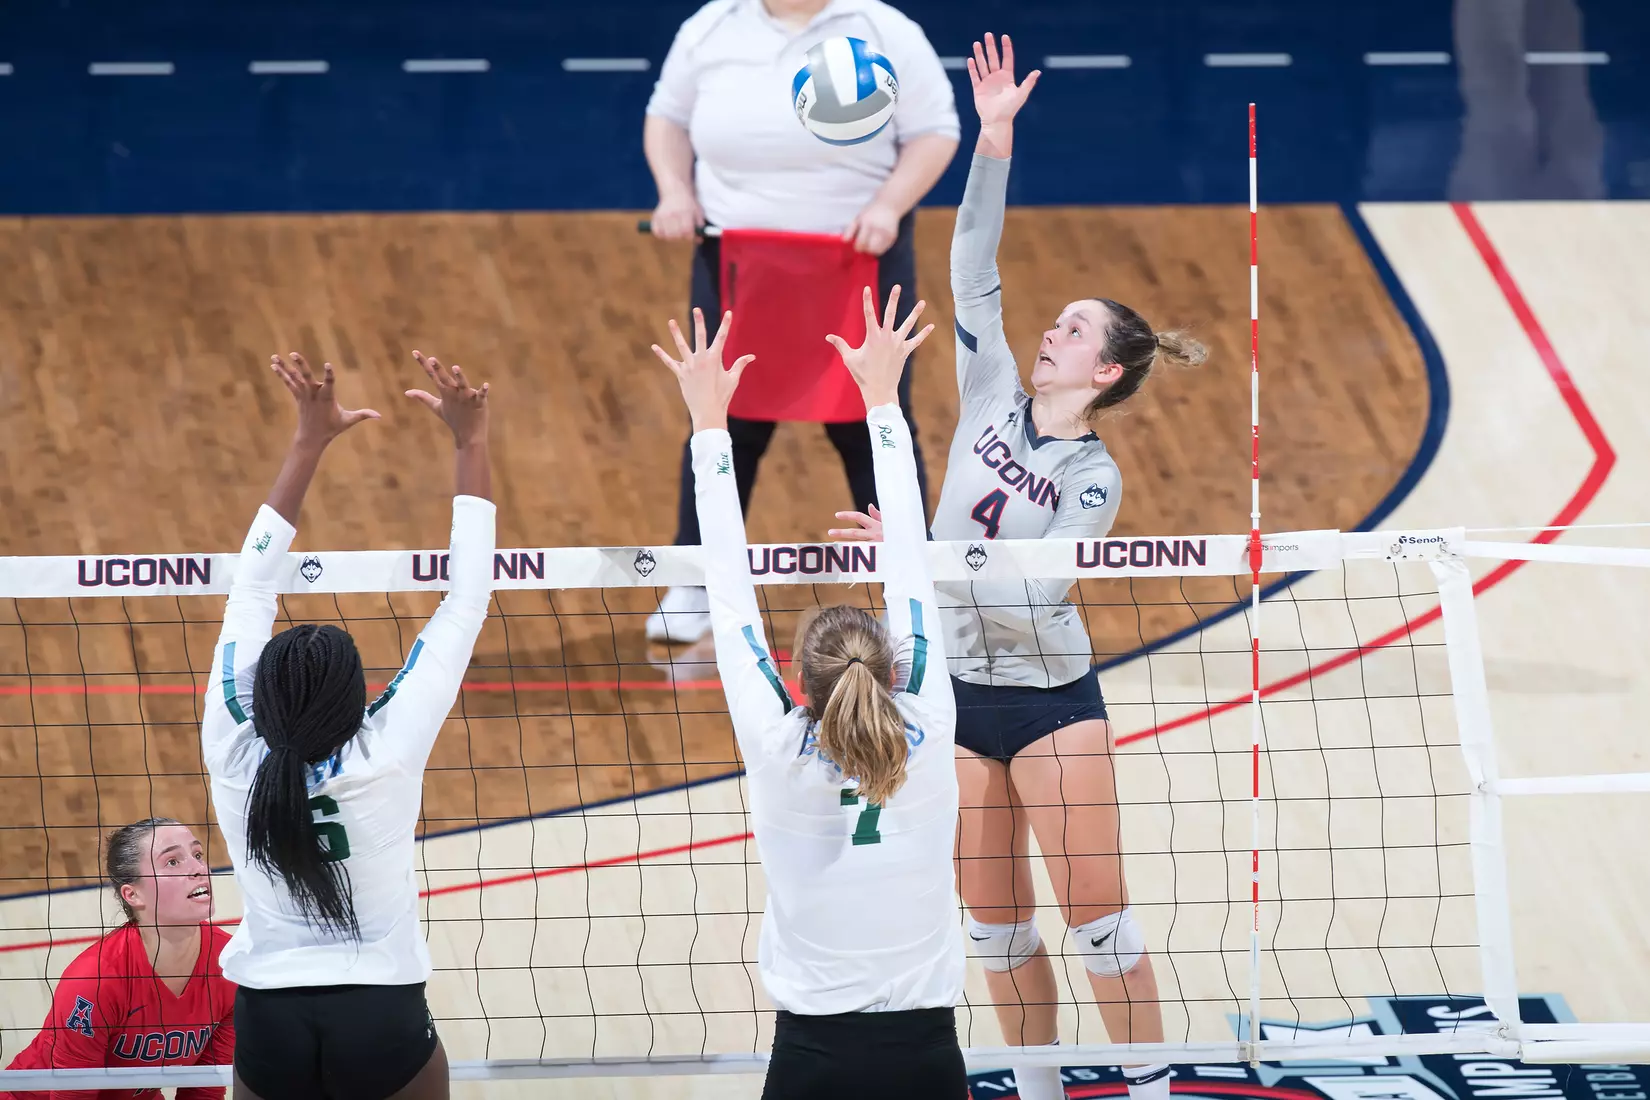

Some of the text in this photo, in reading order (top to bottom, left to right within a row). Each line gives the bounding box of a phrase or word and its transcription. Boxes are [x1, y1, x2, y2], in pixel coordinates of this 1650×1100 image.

[973, 425, 1062, 513] UCONN
[971, 487, 1010, 541] 4
[1076, 539, 1207, 569] UCONN
[1408, 535, 1444, 545] Senoh
[77, 557, 211, 587] UCONN
[412, 552, 545, 582] UNN
[747, 545, 877, 576] UCONN
[840, 788, 882, 846] 7
